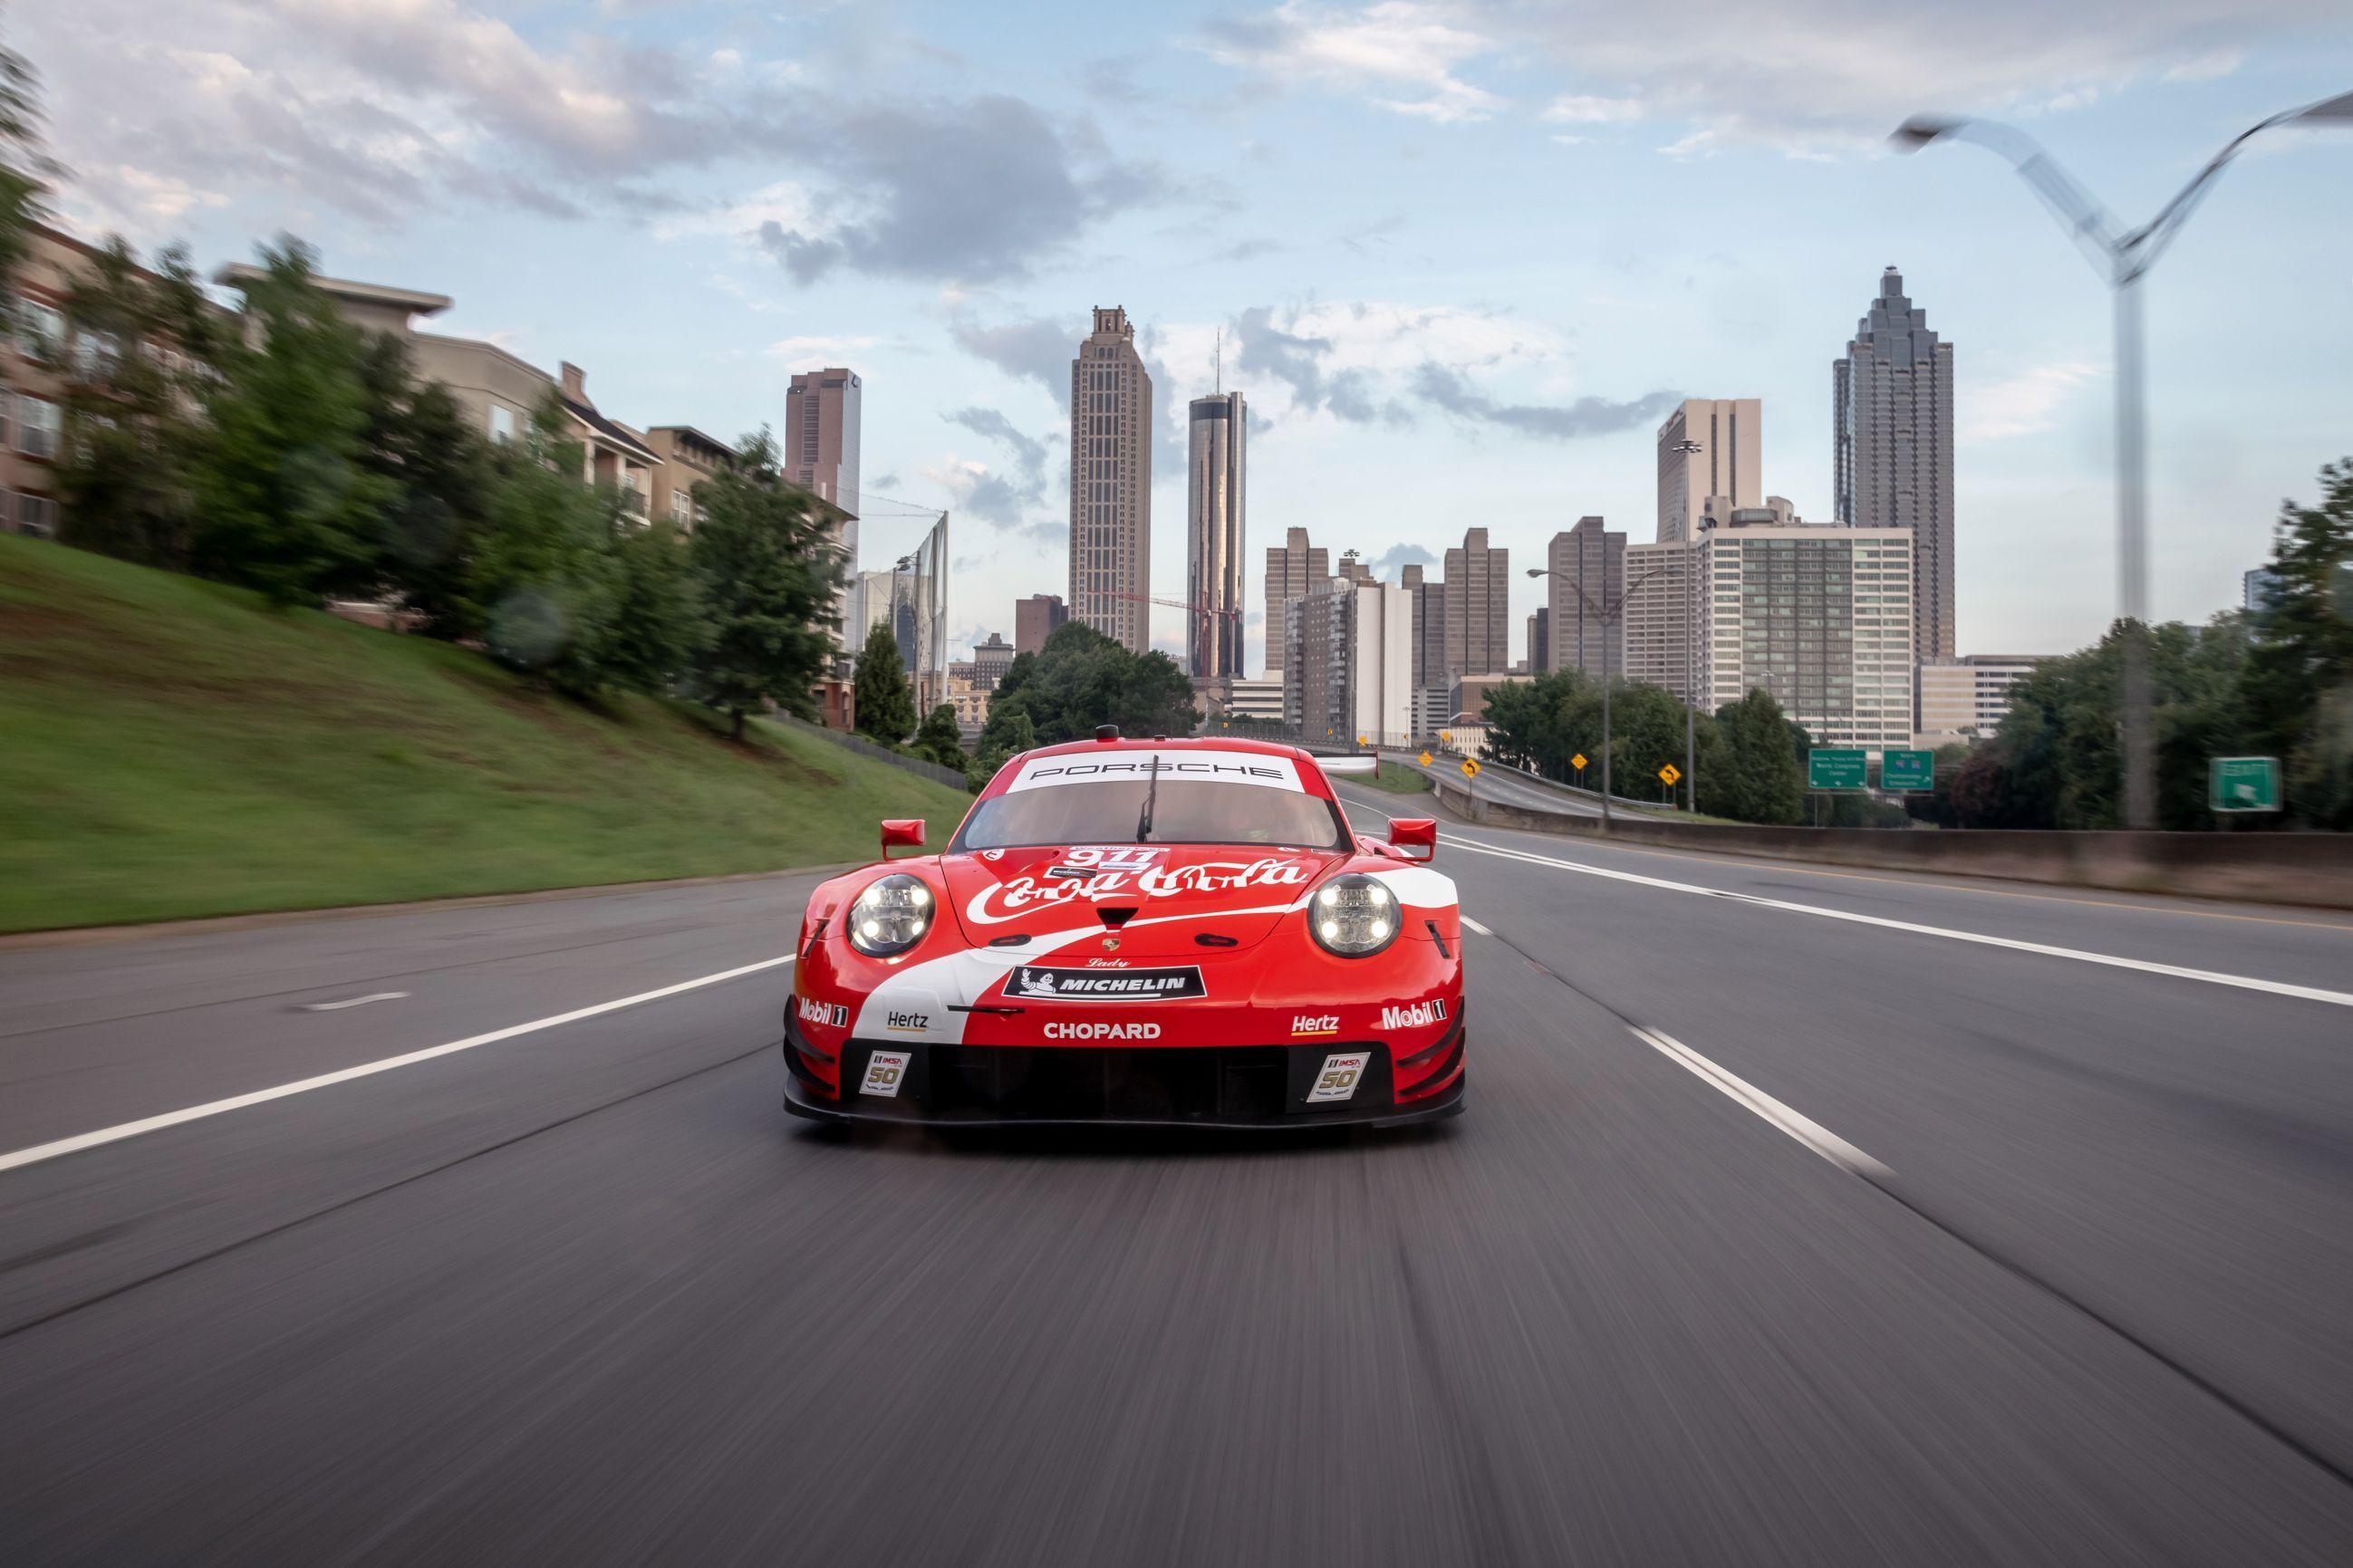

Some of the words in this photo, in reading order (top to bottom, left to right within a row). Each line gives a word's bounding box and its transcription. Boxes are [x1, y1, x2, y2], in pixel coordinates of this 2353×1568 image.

[1029, 763, 1285, 781] PORSCHE
[1063, 850, 1159, 867] 911
[1059, 976, 1186, 992] MICHELIN
[798, 996, 832, 1024] Mobil
[1382, 1001, 1434, 1030] Mobil
[887, 1011, 930, 1028] Hertz
[1292, 1015, 1340, 1032] Hertz
[1043, 1022, 1162, 1040] CHOPARD
[867, 1066, 901, 1084] 50
[1318, 1070, 1358, 1089] 50
